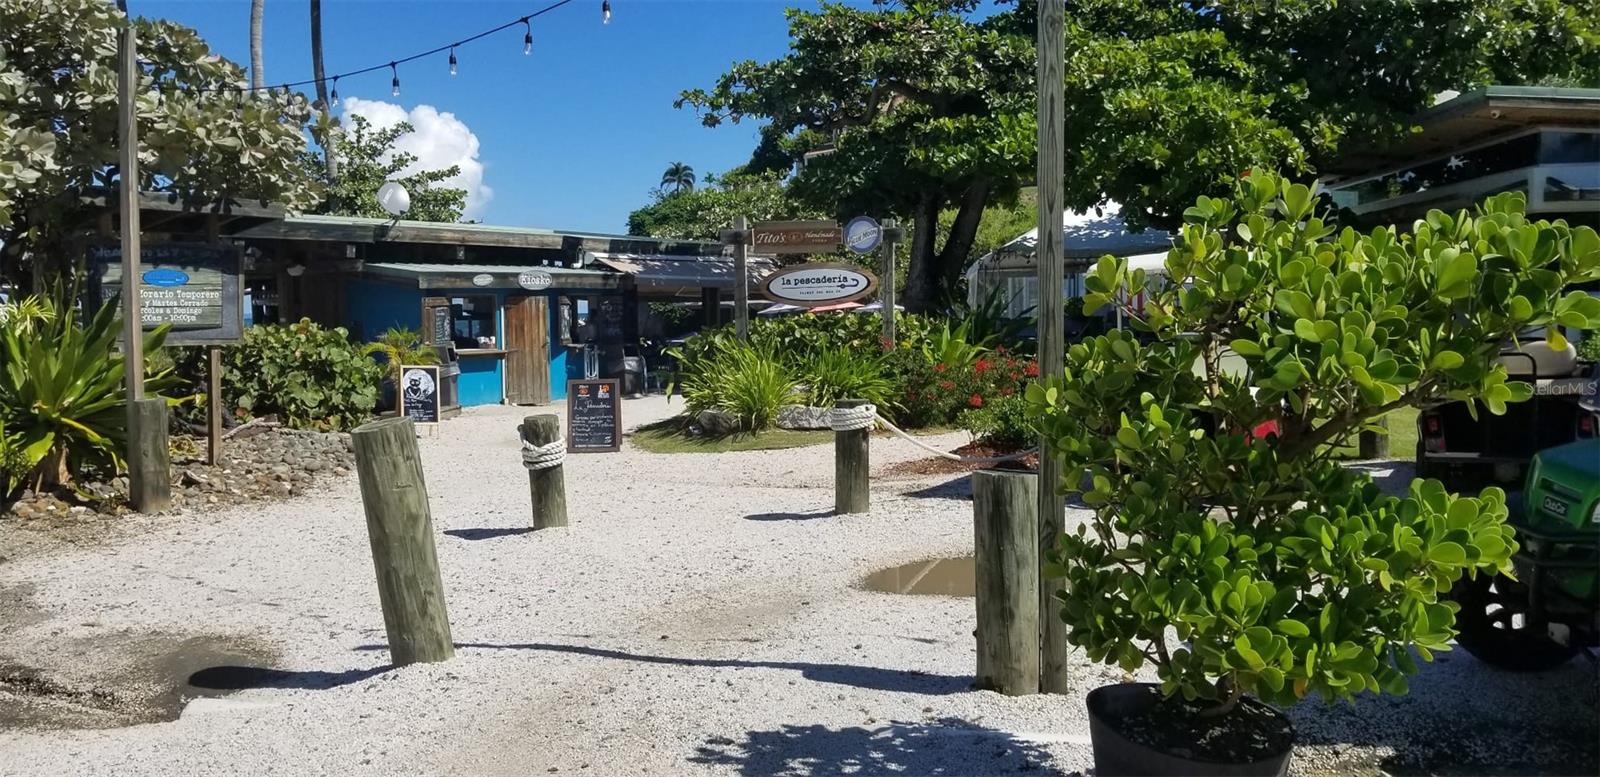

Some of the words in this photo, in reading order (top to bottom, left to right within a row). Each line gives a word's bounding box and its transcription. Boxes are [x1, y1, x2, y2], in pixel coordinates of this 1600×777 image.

[756, 232, 787, 244] Tito's
[520, 275, 551, 285] Kiosko
[781, 277, 791, 286] la
[173, 308, 203, 317] Domingo
